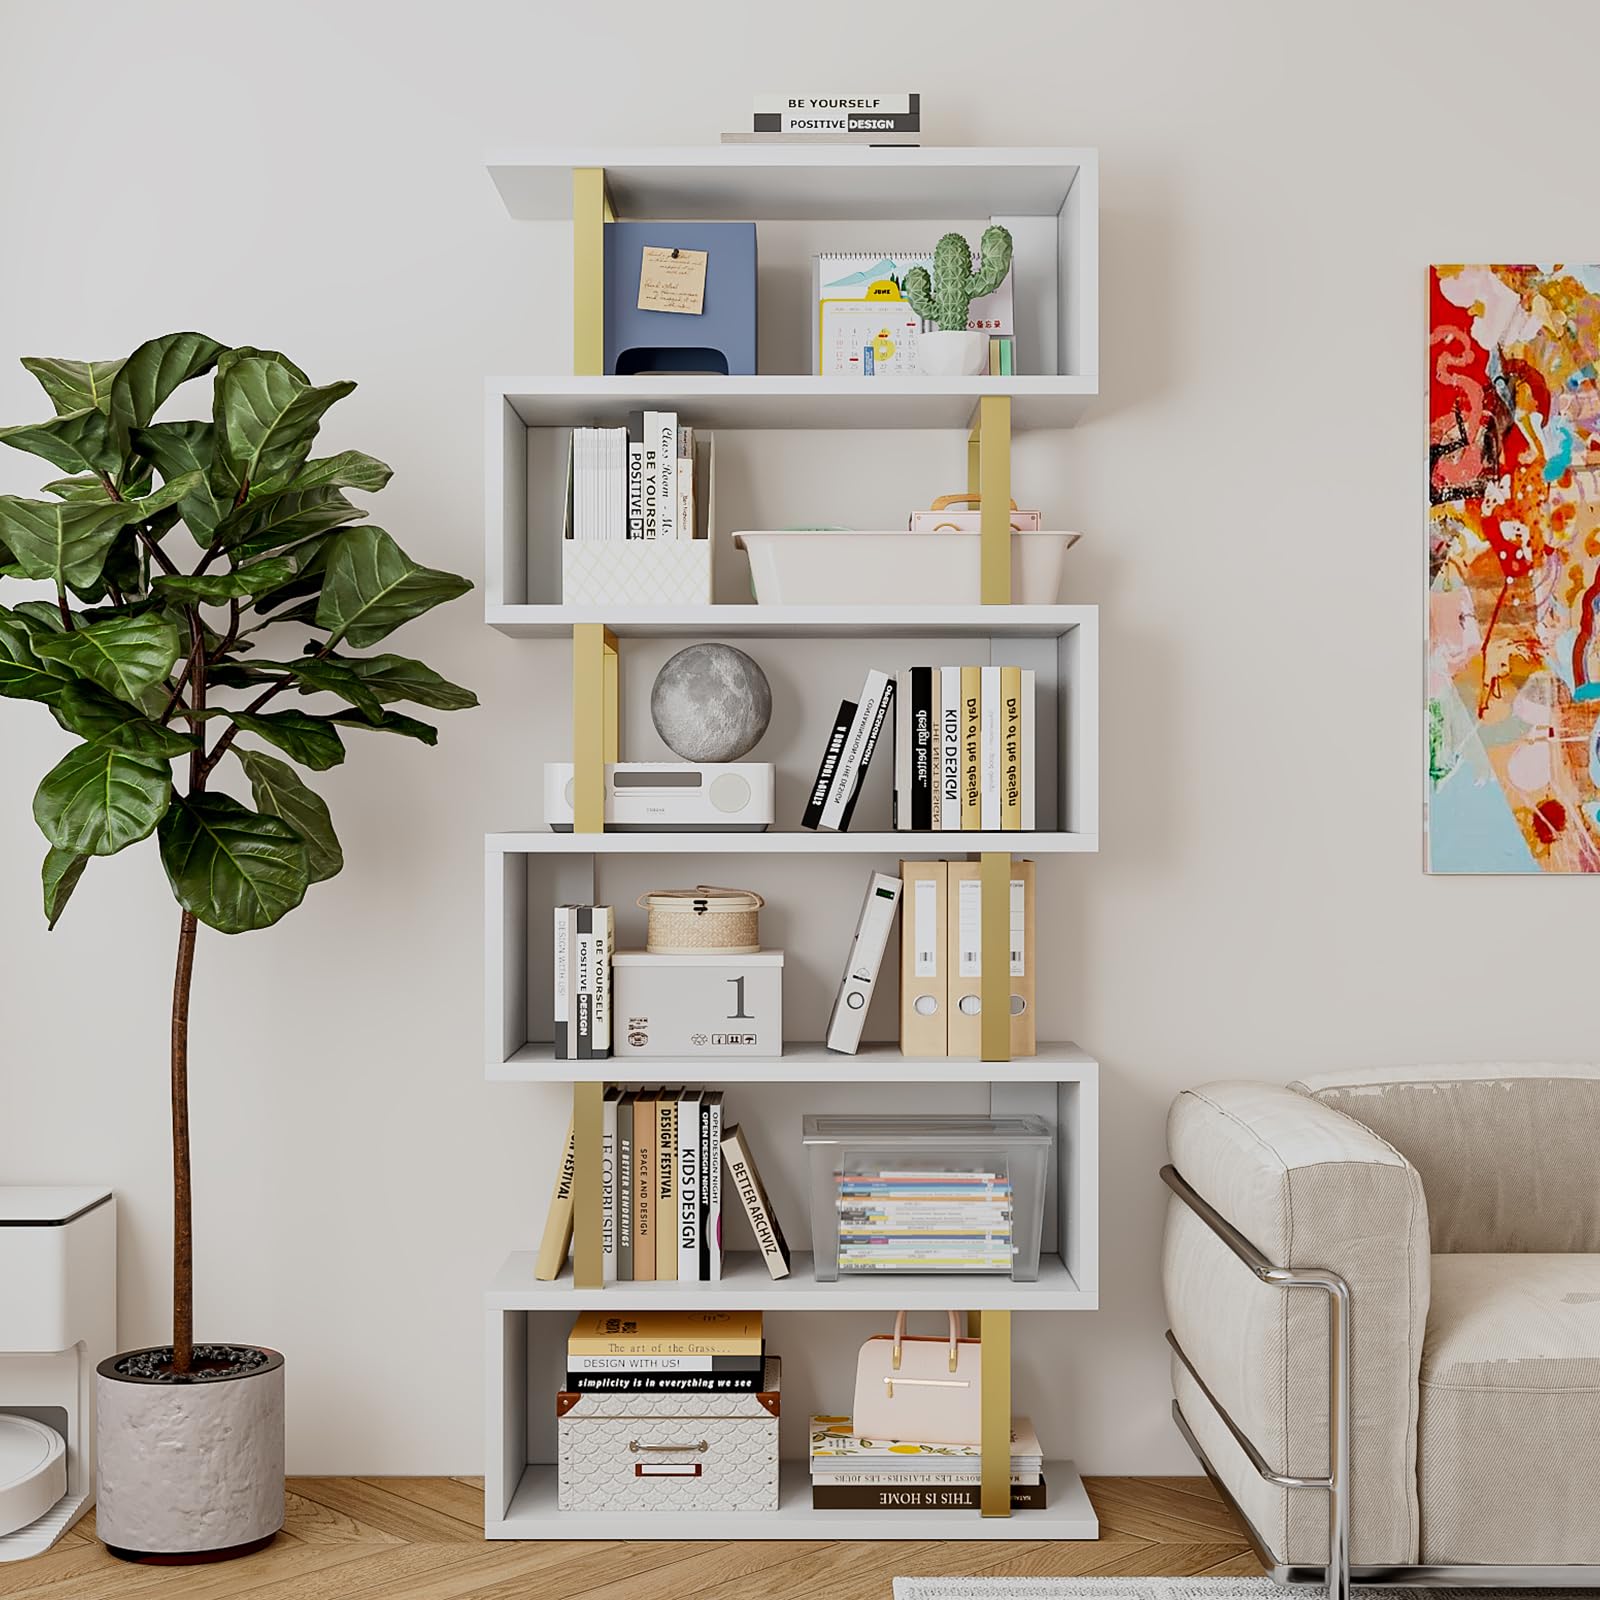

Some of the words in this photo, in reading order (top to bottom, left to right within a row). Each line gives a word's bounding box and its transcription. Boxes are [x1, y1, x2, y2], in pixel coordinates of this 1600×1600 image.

[788, 99, 805, 108] BE
[810, 99, 880, 108] YOURSELF
[790, 120, 846, 129] POSITIVE
[850, 120, 894, 129] DESIGN
[662, 427, 672, 459] Class
[647, 451, 655, 469] BE
[631, 453, 642, 515] POSITIVE
[662, 464, 672, 498] Room
[647, 476, 655, 540] YOURSE
[662, 514, 672, 536] Ms.
[596, 940, 603, 955] BE
[727, 976, 755, 1018] 1
[661, 1109, 671, 1148] DESIGN
[622, 1140, 630, 1152] BE
[622, 1154, 630, 1186] BETTER
[661, 1153, 671, 1199] FESTIVAL
[682, 1149, 695, 1185] KIDS
[622, 1189, 630, 1247] RENDERINGS
[682, 1190, 695, 1249] DESIGN
[732, 1161, 756, 1204] BETTER
[749, 1206, 776, 1255] ARCHVIZ
[608, 1344, 624, 1352] The
[630, 1344, 645, 1352] art
[651, 1344, 662, 1352] of
[668, 1344, 681, 1352] the
[688, 1344, 730, 1353] Grass...
[583, 1359, 625, 1368] DESIGN
[630, 1359, 657, 1368] WITH
[662, 1359, 680, 1368] US!
[578, 1378, 630, 1389] simplicity
[633, 1379, 642, 1387] is
[645, 1379, 655, 1387] in
[659, 1378, 714, 1389] everything
[880, 1493, 920, 1504] HOME
[925, 1493, 937, 1504] IS
[941, 1493, 972, 1504] THIS
